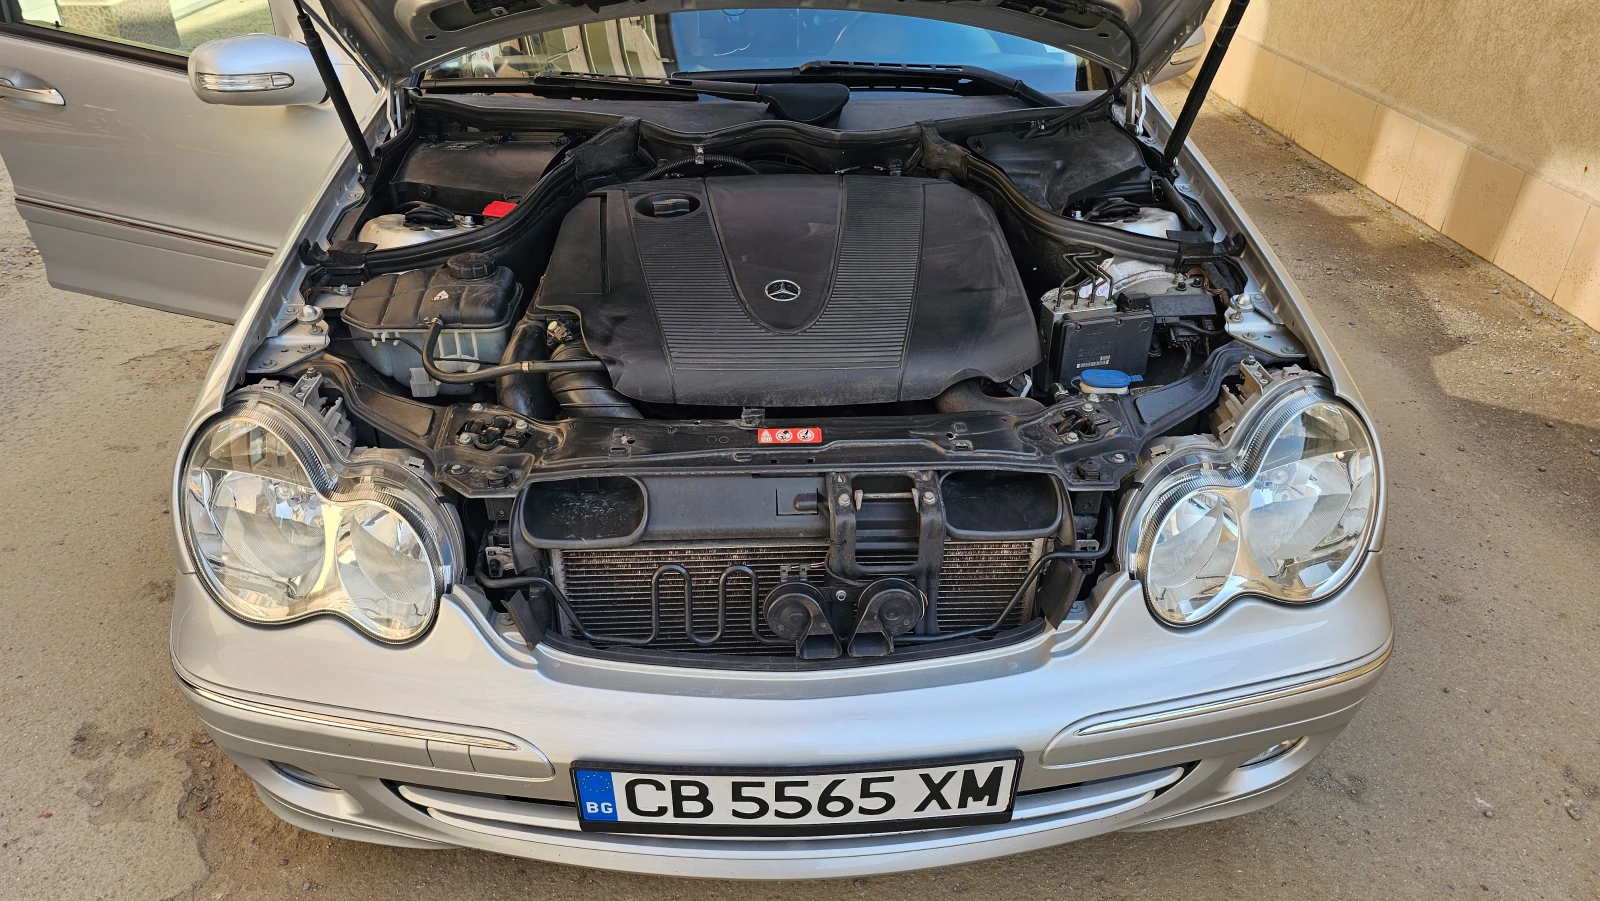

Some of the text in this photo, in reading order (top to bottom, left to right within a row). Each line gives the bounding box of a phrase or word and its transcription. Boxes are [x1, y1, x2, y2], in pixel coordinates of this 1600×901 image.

[586, 801, 613, 814] BG
[624, 766, 1004, 819] CB 5565 XM
